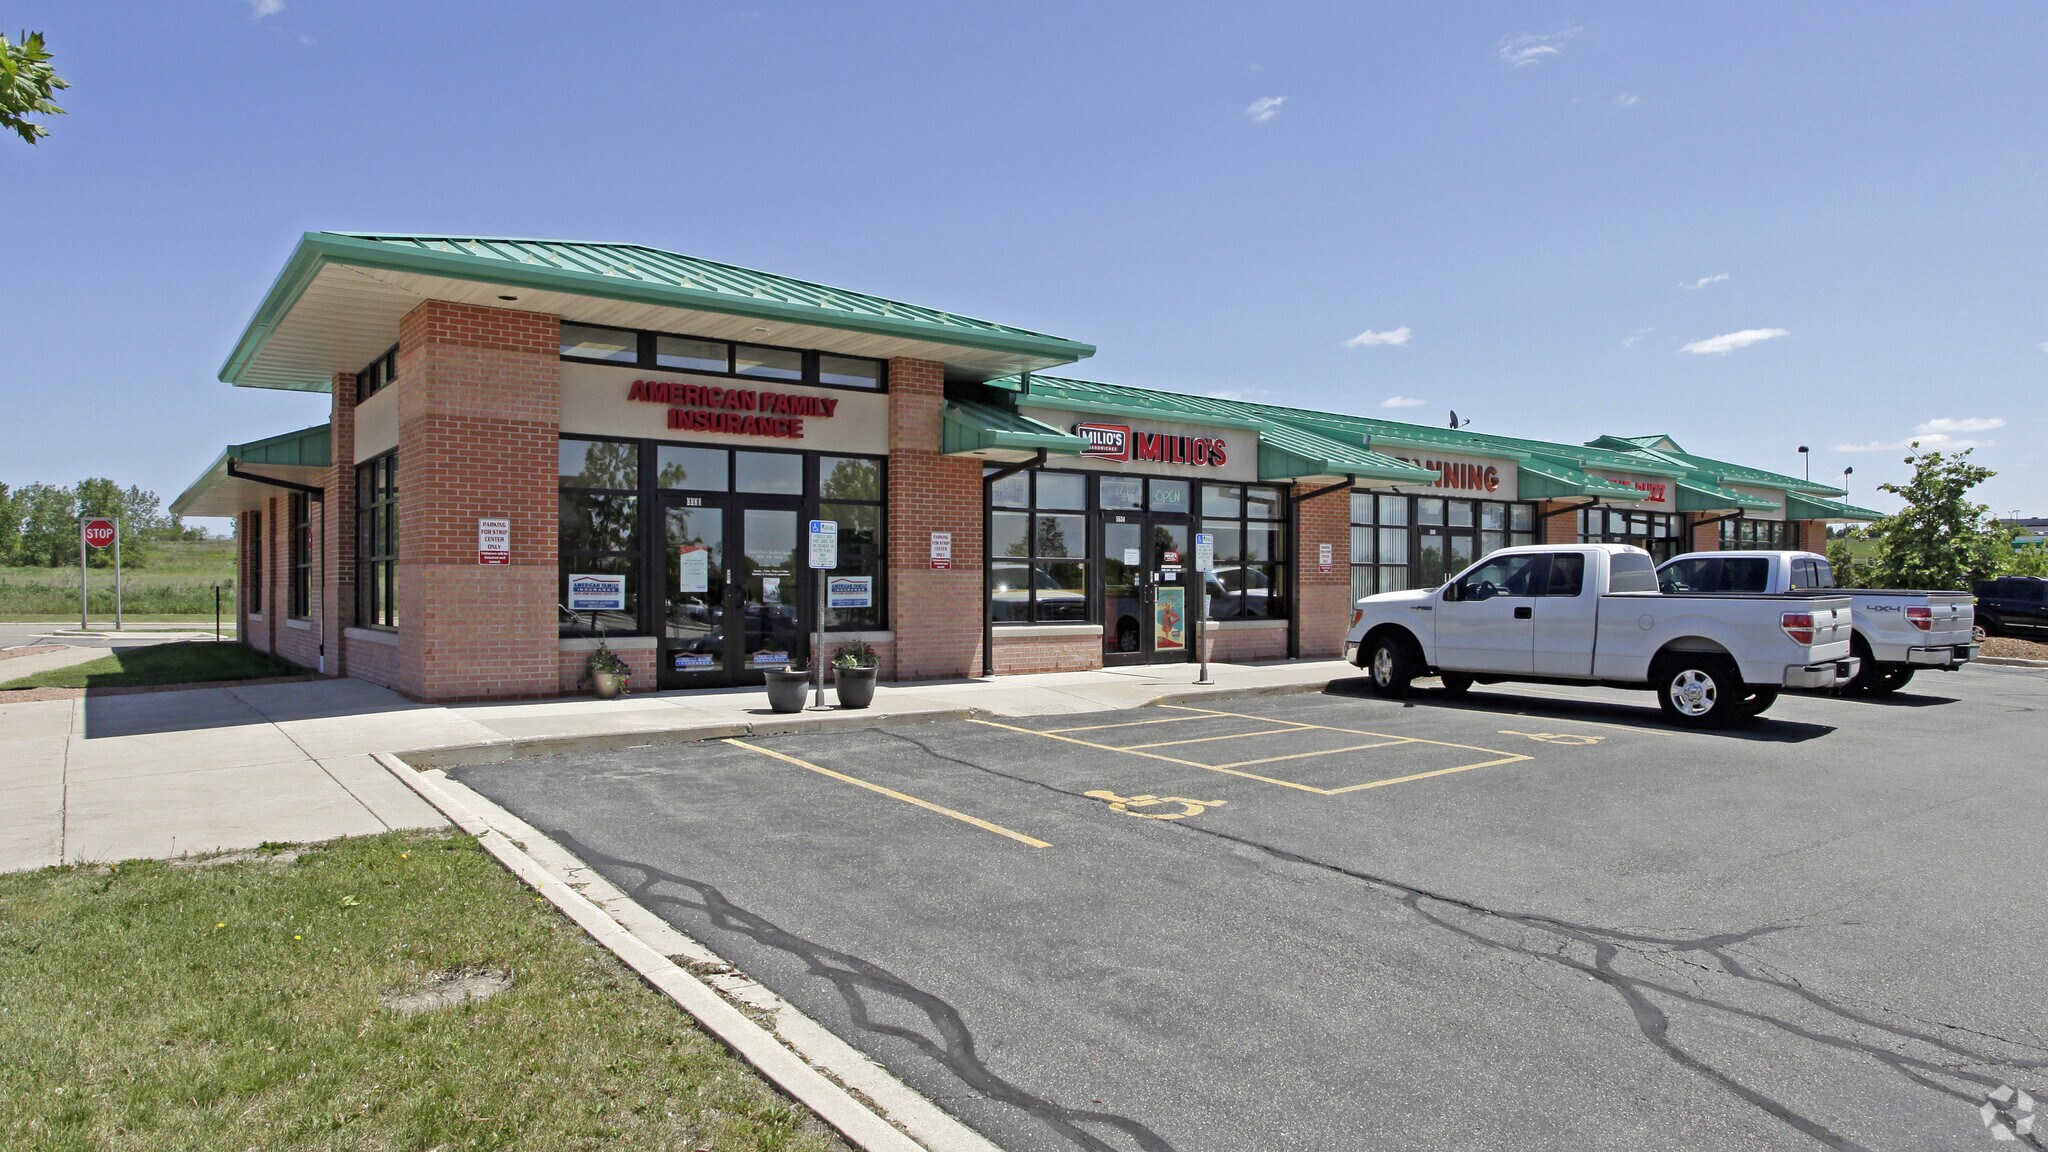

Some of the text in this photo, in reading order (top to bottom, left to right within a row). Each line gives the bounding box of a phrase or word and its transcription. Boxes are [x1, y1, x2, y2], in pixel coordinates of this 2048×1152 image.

[628, 380, 839, 418] AMERICAN FAMILY
[667, 409, 804, 438] INSURANCE
[1082, 430, 1122, 446] MILIO'S
[1136, 431, 1227, 466] MILIO'S
[1155, 489, 1180, 502] OPEN
[86, 528, 113, 539] STOP
